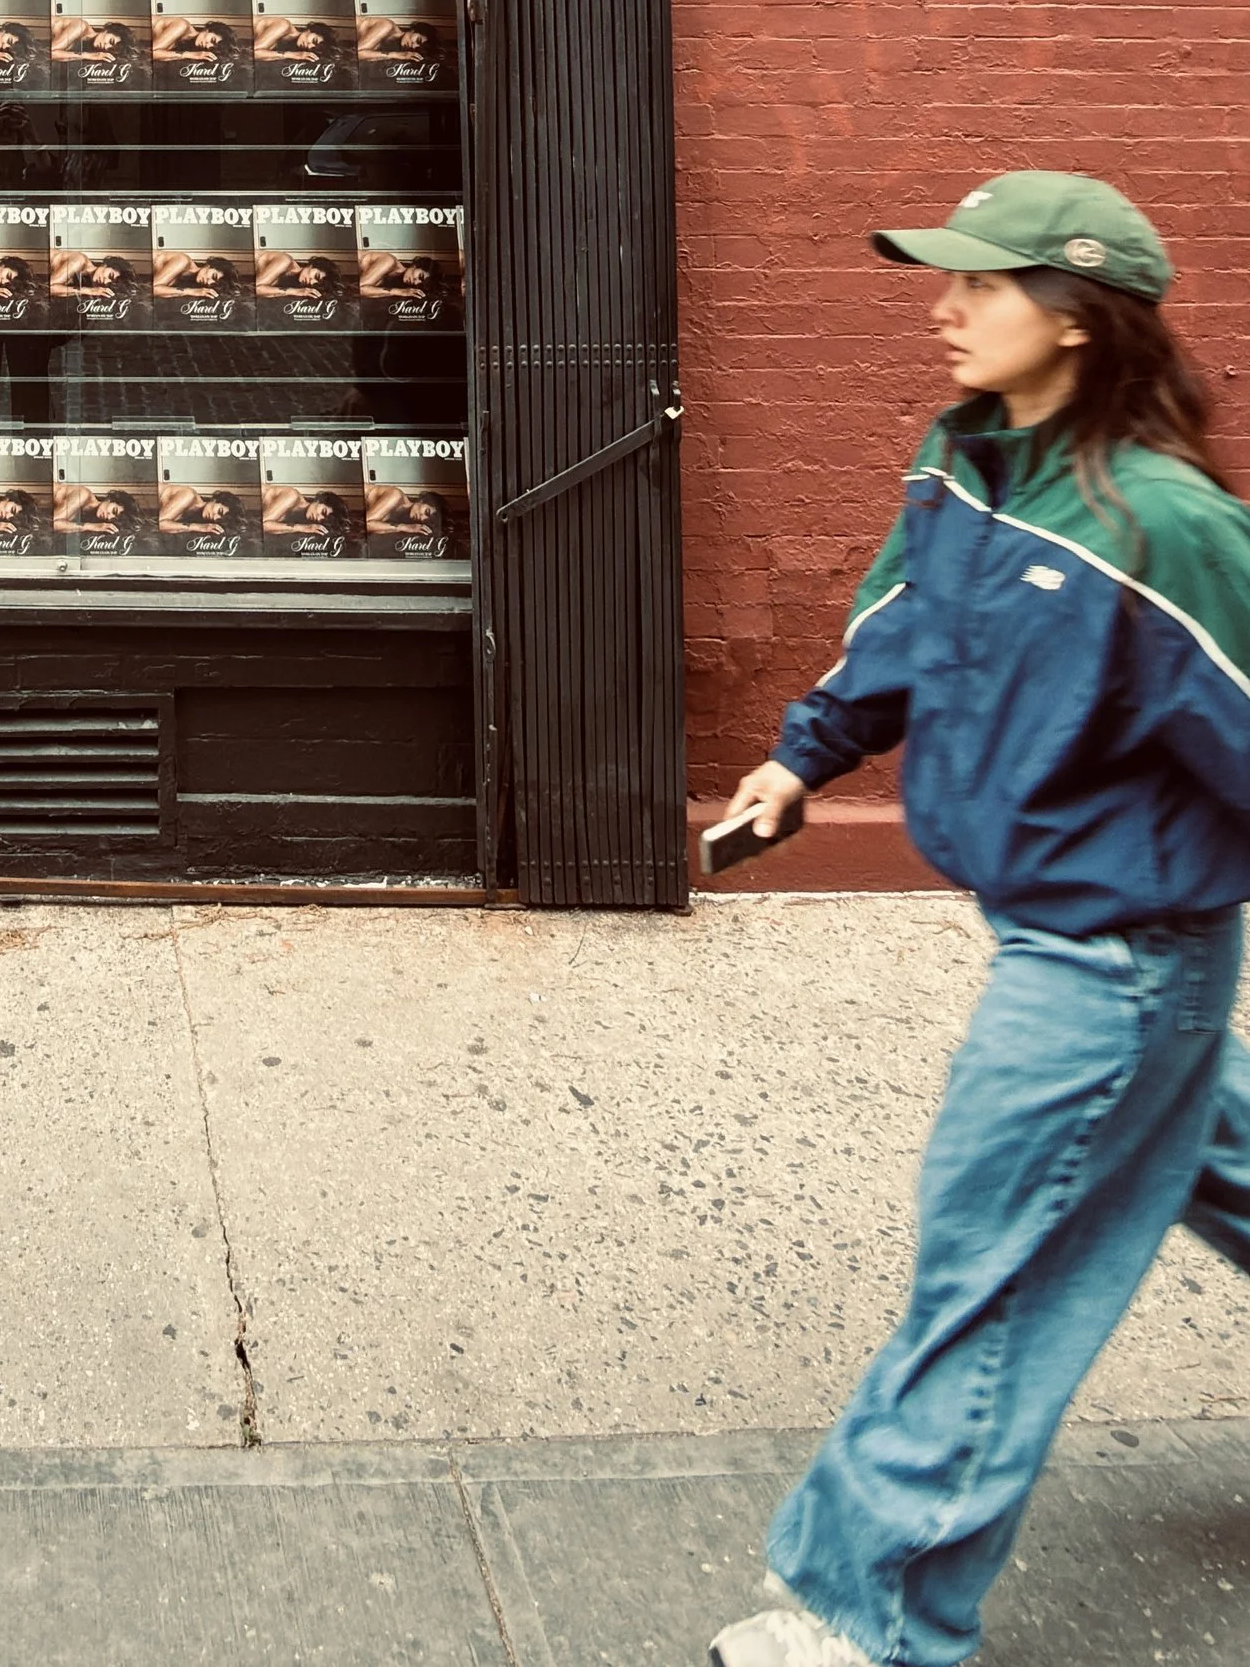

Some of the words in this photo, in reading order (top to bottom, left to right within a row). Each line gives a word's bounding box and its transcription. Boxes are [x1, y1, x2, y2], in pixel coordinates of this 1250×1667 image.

[53, 207, 150, 225] PLAYBOY
[155, 207, 252, 225] PLAYBOY
[256, 207, 353, 225] PLAYBOY
[359, 207, 456, 225] PLAYBOY
[57, 437, 155, 456] PLAYBOY
[160, 437, 259, 456] PLAYBOY
[263, 437, 361, 456] PLAYBOY
[365, 437, 464, 456] PLAYBOY
